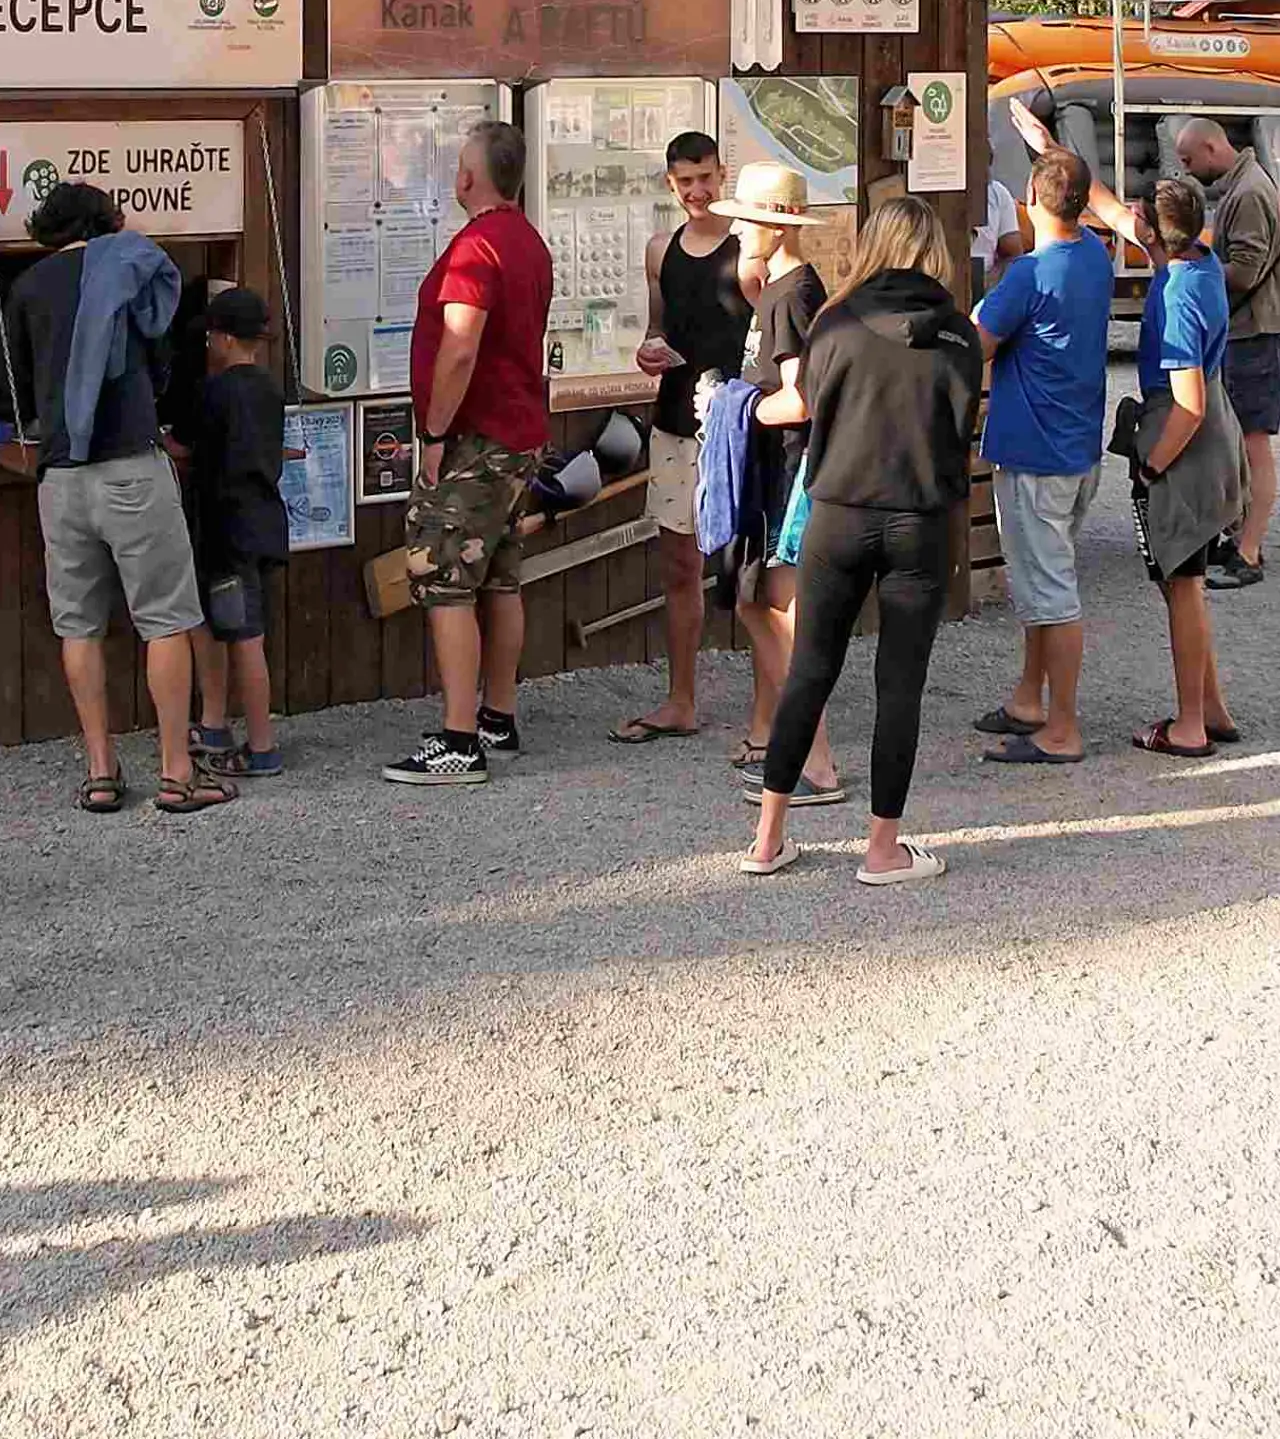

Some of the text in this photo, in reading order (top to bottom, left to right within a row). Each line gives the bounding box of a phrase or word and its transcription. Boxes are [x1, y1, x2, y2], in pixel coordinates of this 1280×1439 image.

[67, 142, 231, 174] ZDE UHRAĎTE
[111, 181, 192, 213] POVNÉ
